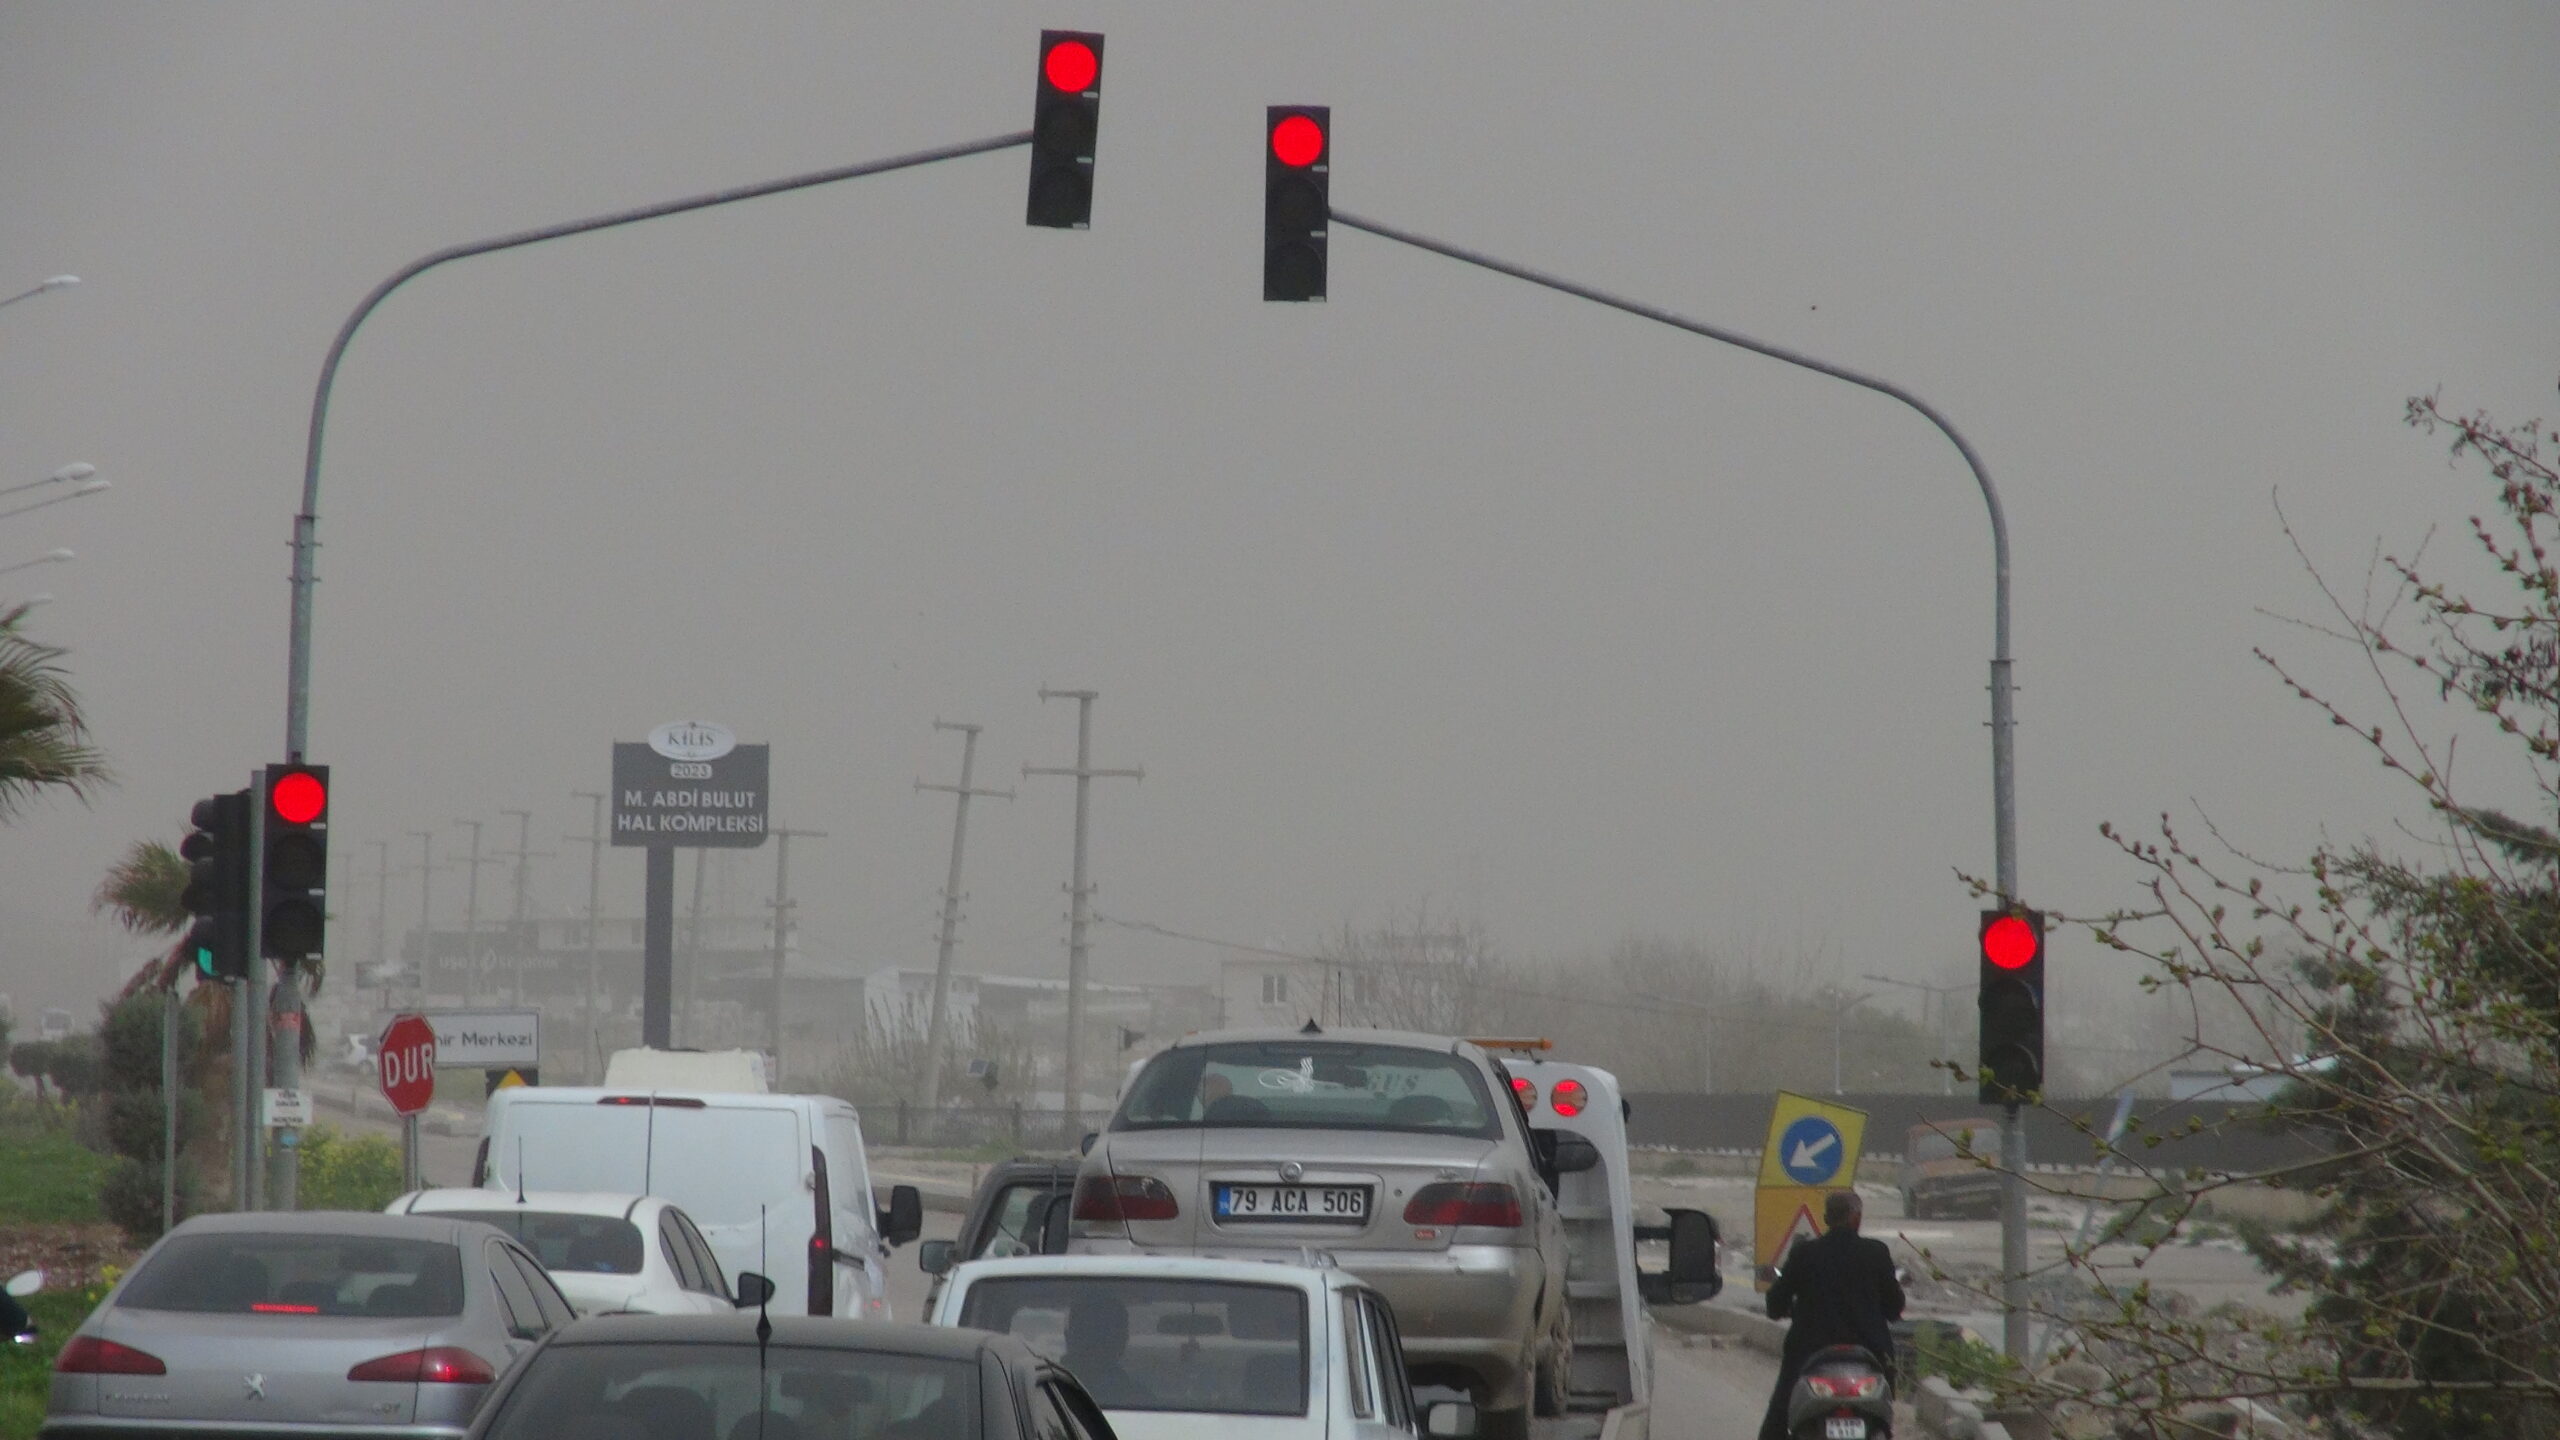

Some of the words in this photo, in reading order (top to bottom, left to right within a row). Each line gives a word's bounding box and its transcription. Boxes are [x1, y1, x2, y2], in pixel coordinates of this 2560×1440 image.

[674, 765, 709, 777] 2023
[624, 790, 647, 808] M.
[702, 791, 756, 809] BULUT
[618, 814, 655, 831] HAL
[462, 1031, 533, 1048] Merkezi
[384, 1043, 434, 1089] DUR
[1232, 1189, 1258, 1212] 79
[1271, 1190, 1309, 1212] ACA
[1323, 1191, 1362, 1213] 506
